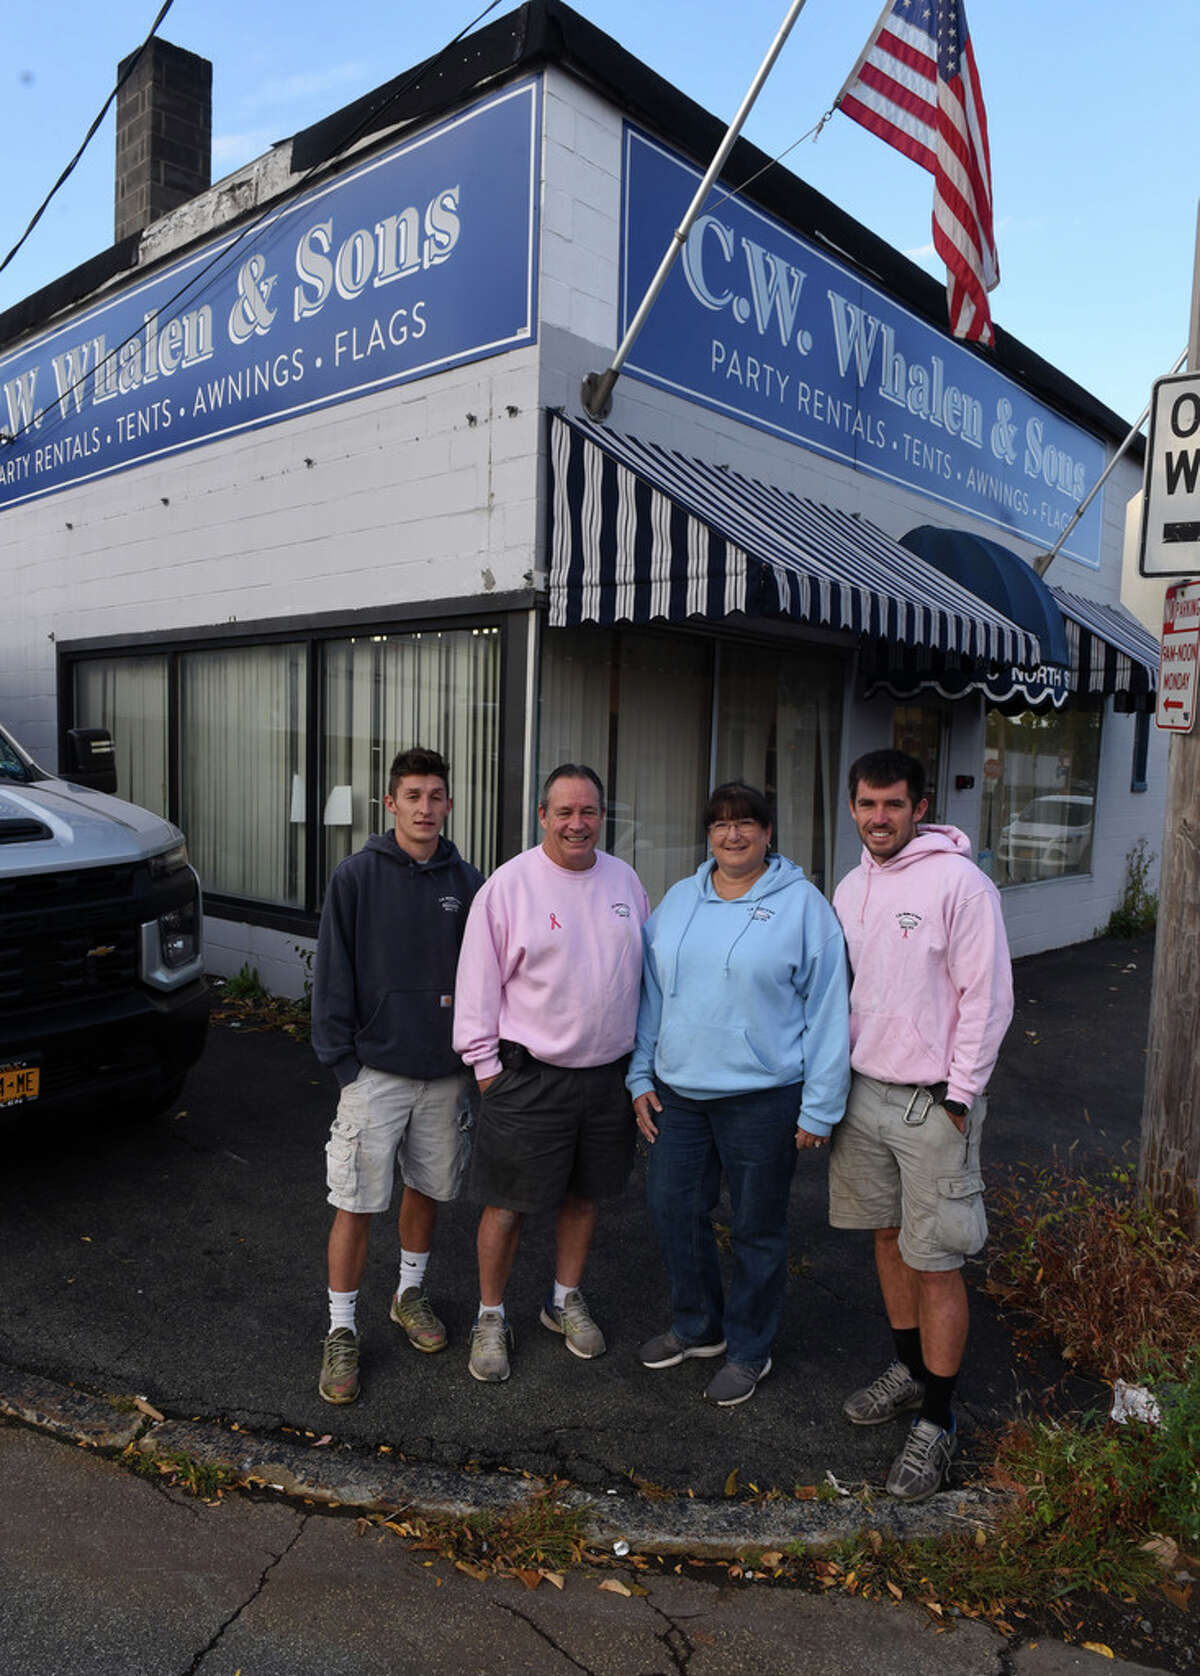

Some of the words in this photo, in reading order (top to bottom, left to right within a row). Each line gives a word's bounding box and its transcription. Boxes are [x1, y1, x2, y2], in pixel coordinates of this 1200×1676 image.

[52, 304, 214, 419] Whalen
[228, 254, 278, 345] &
[293, 184, 461, 322] Sons
[0, 453, 31, 486] ARTY
[35, 426, 101, 474] RENTALS
[116, 399, 173, 443] TENTS
[192, 348, 304, 418] AWNINGS
[334, 301, 427, 367] FLAGS
[682, 214, 813, 356] C.W.
[827, 289, 983, 449] Whalen
[991, 398, 1018, 466] &
[1024, 417, 1086, 502] Sons
[712, 339, 790, 404] PARTY
[798, 381, 886, 448] RENTALS
[903, 433, 952, 480] TENTS
[965, 467, 1029, 516] AWNINGS
[1171, 392, 1200, 438] O
[1165, 449, 1200, 495] W
[1012, 665, 1060, 687] NORTH
[1163, 671, 1190, 691] MONDAY
